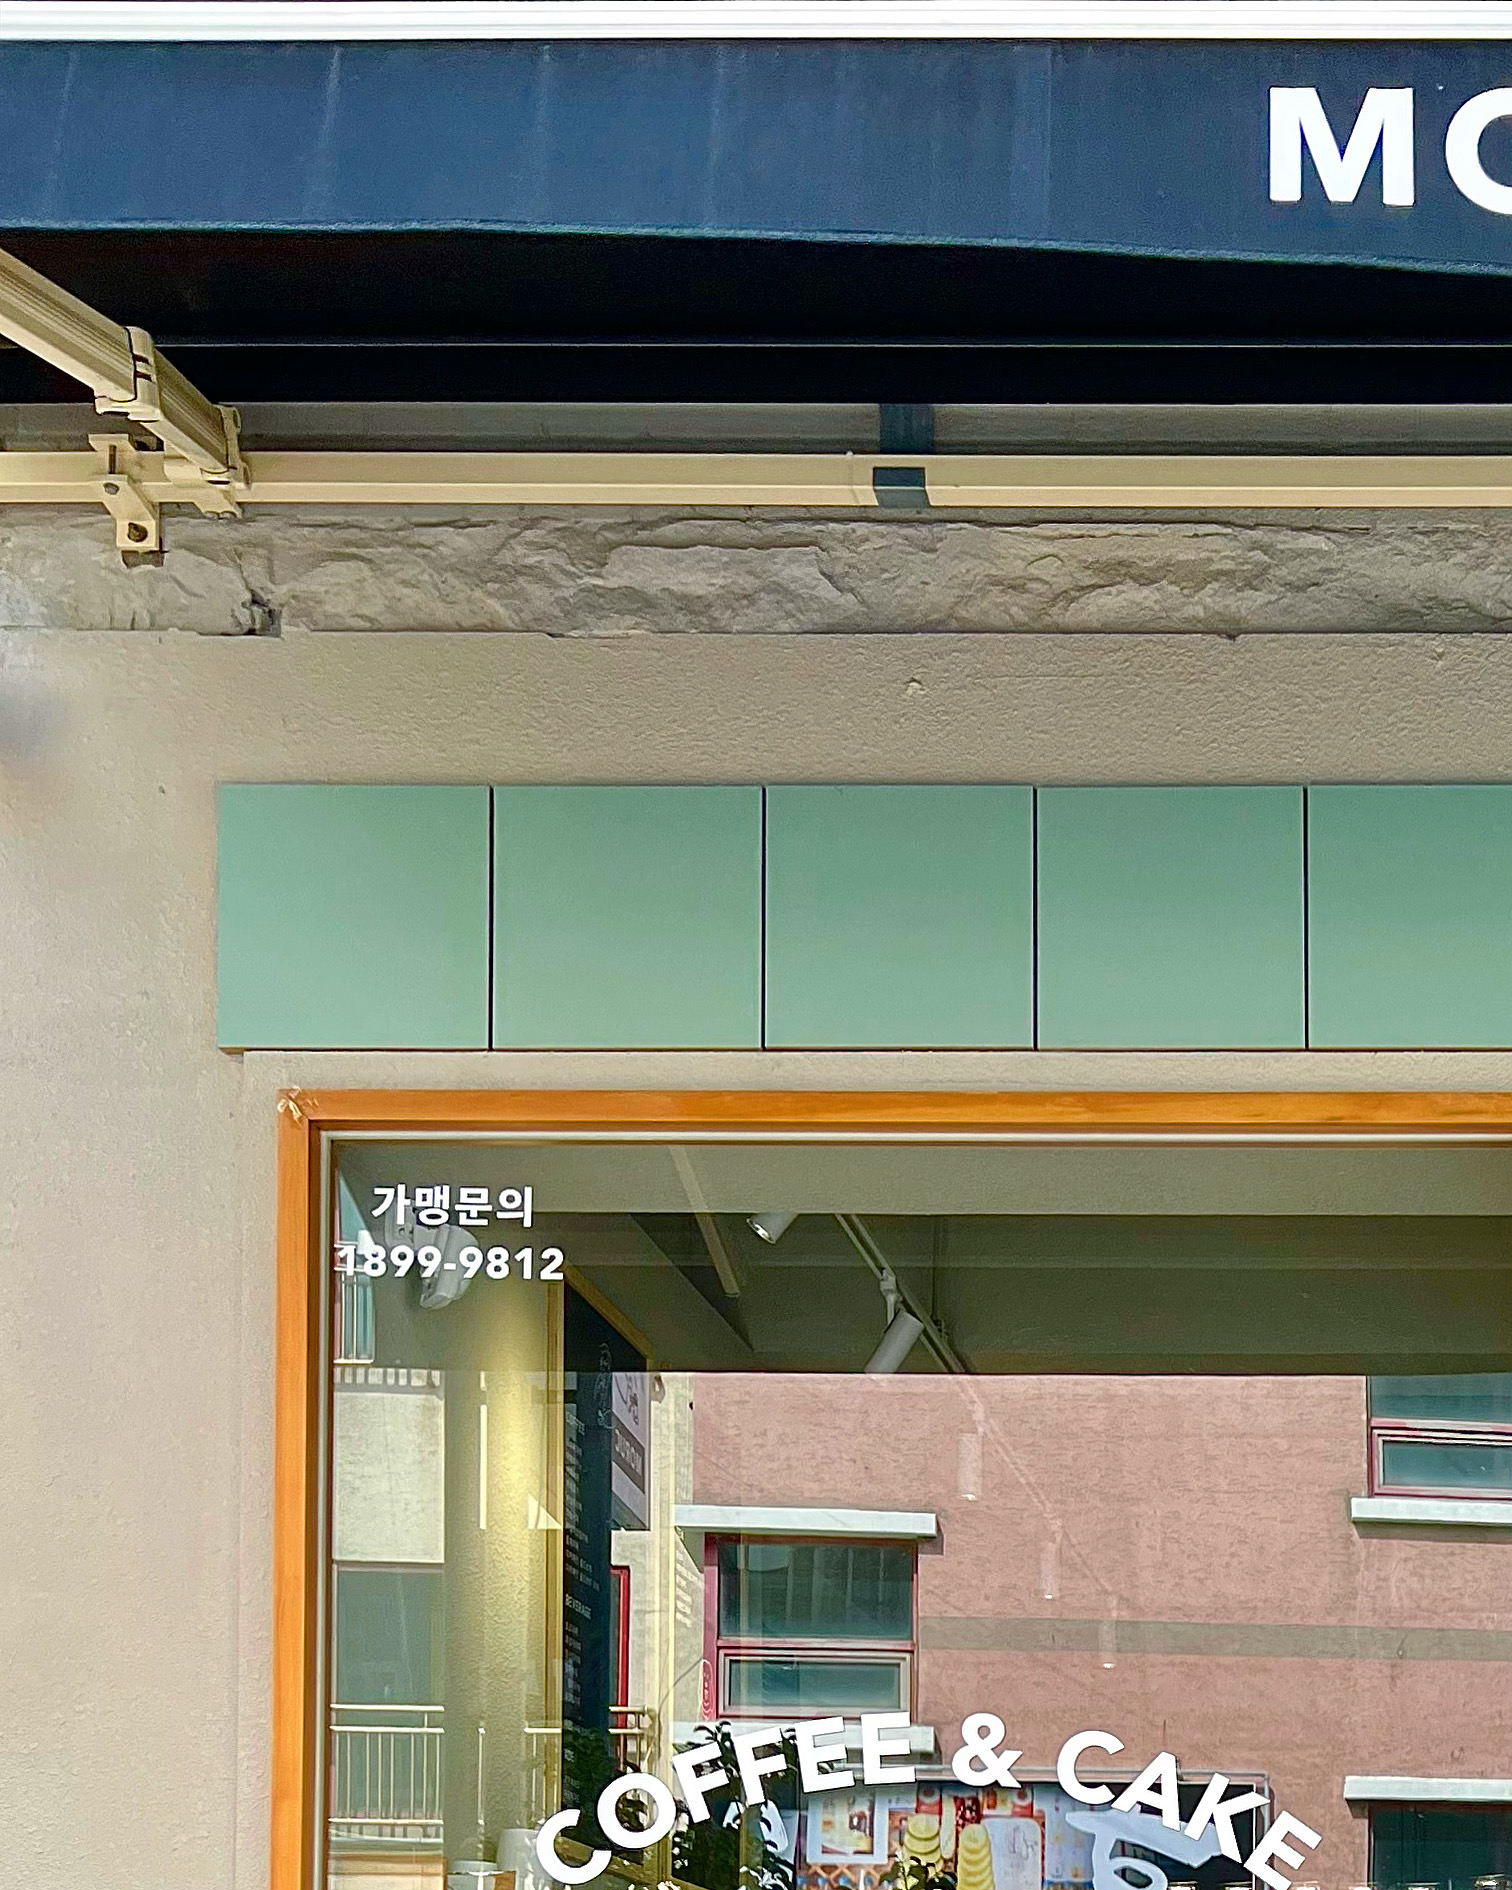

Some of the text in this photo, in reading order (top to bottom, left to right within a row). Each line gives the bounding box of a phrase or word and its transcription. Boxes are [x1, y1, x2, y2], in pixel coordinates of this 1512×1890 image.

[371, 1184, 533, 1228] 가맹문의
[338, 1245, 564, 1280] 1899-9812
[535, 1710, 917, 1886] COFFEE
[950, 1712, 1023, 1790] &
